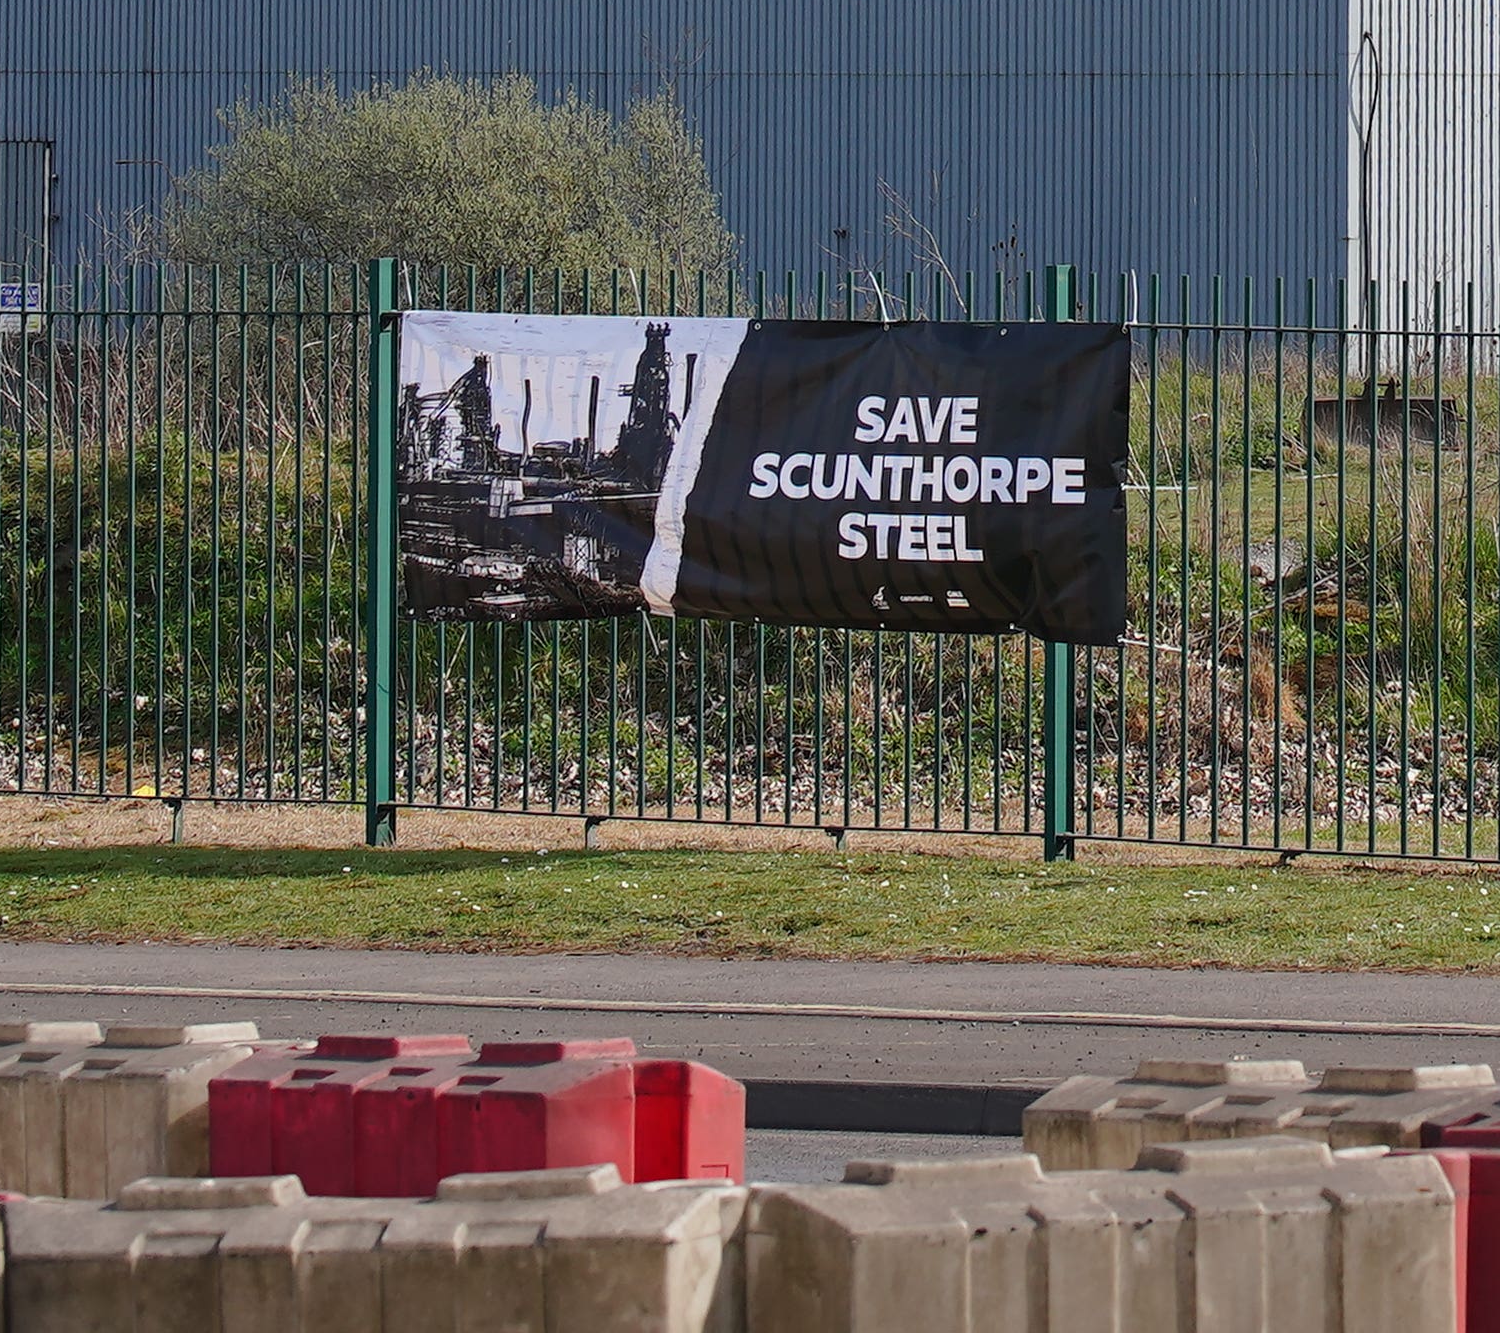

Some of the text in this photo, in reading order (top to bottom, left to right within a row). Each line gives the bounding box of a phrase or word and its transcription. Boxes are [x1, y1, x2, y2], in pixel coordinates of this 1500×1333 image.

[854, 396, 979, 443] SAVE
[749, 452, 1086, 504] SCUNTHORPE
[838, 512, 984, 562] STEEL
